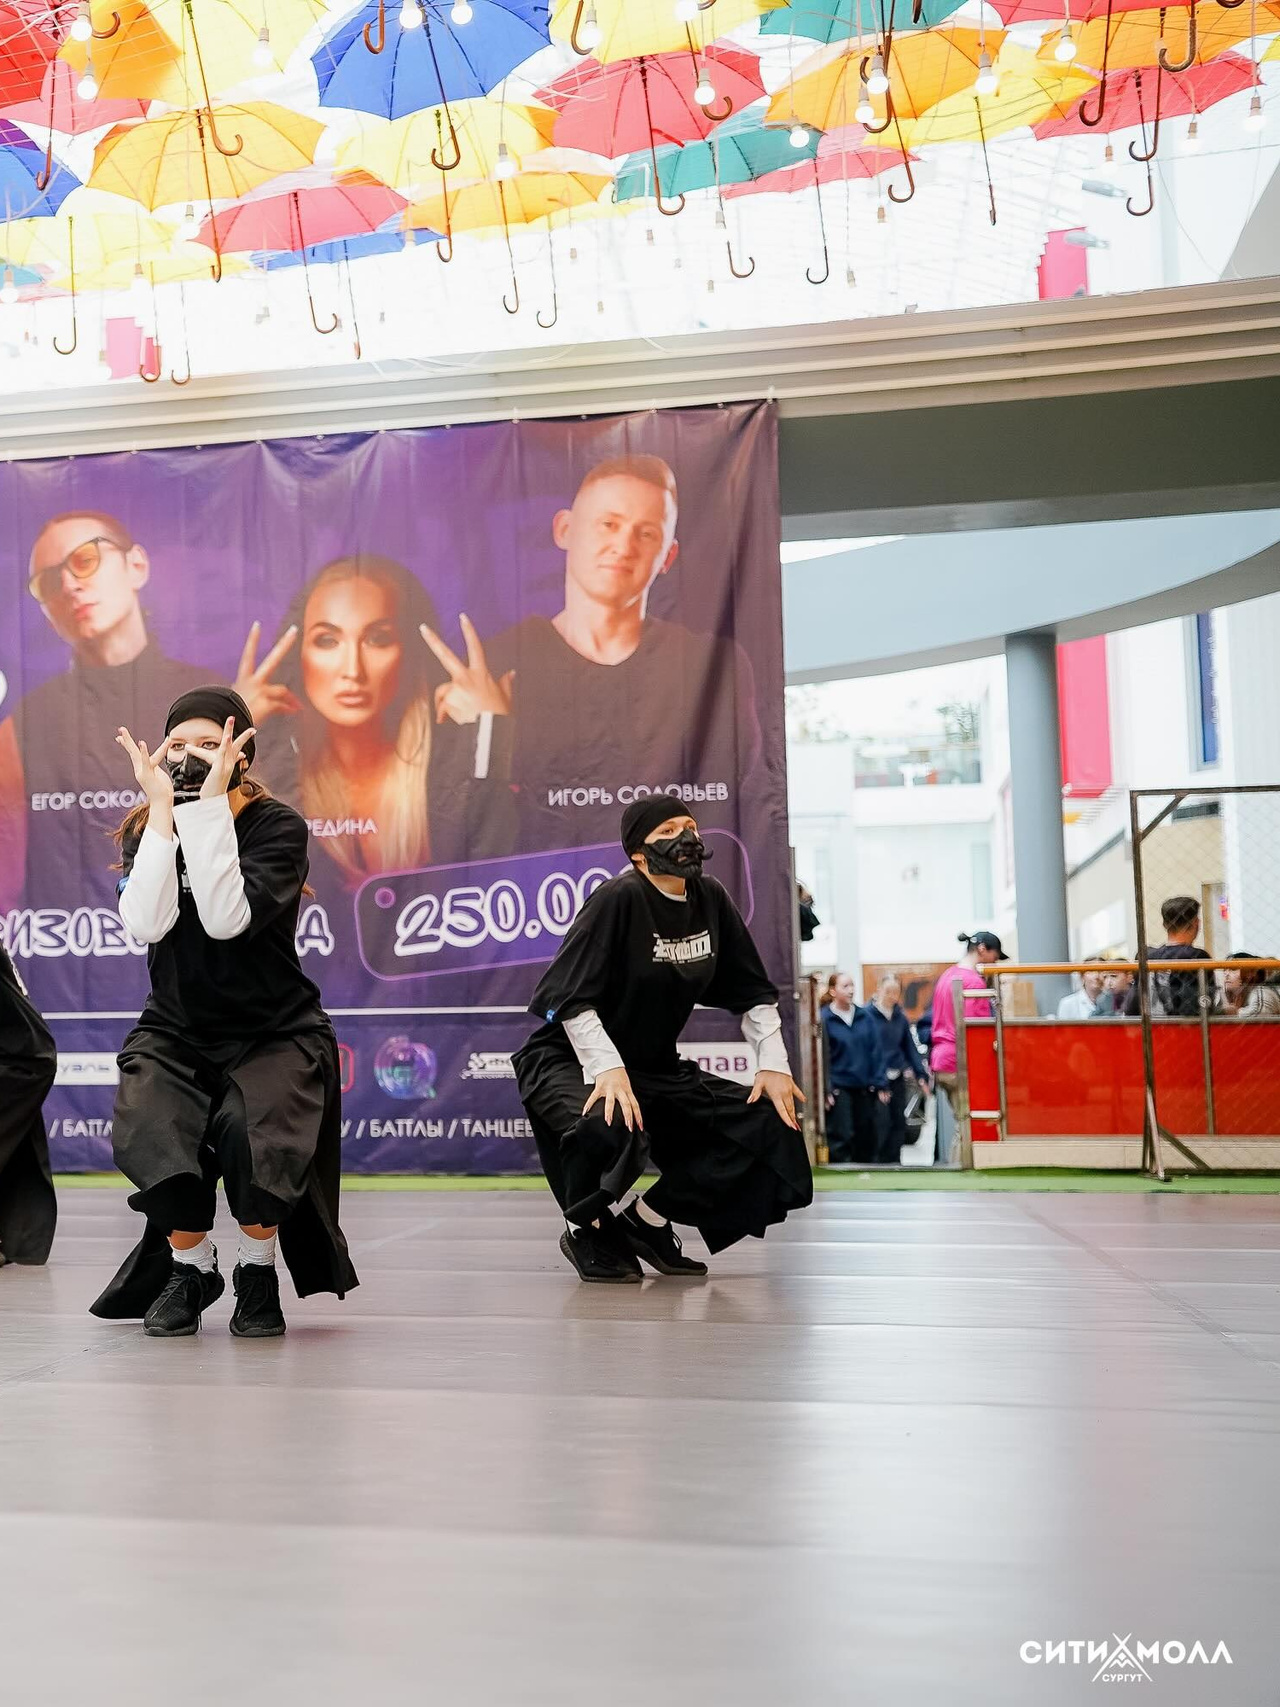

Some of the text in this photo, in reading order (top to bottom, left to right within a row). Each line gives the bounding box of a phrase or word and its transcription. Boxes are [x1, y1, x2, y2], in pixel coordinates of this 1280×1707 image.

[31, 789, 148, 811] ЕГОР СОКОЛ
[548, 787, 614, 807] ИГОРЬ
[304, 817, 379, 838] ЕДИНА
[62, 1118, 114, 1138] БАТТЛ
[369, 1118, 445, 1138] БАТТЛЫ
